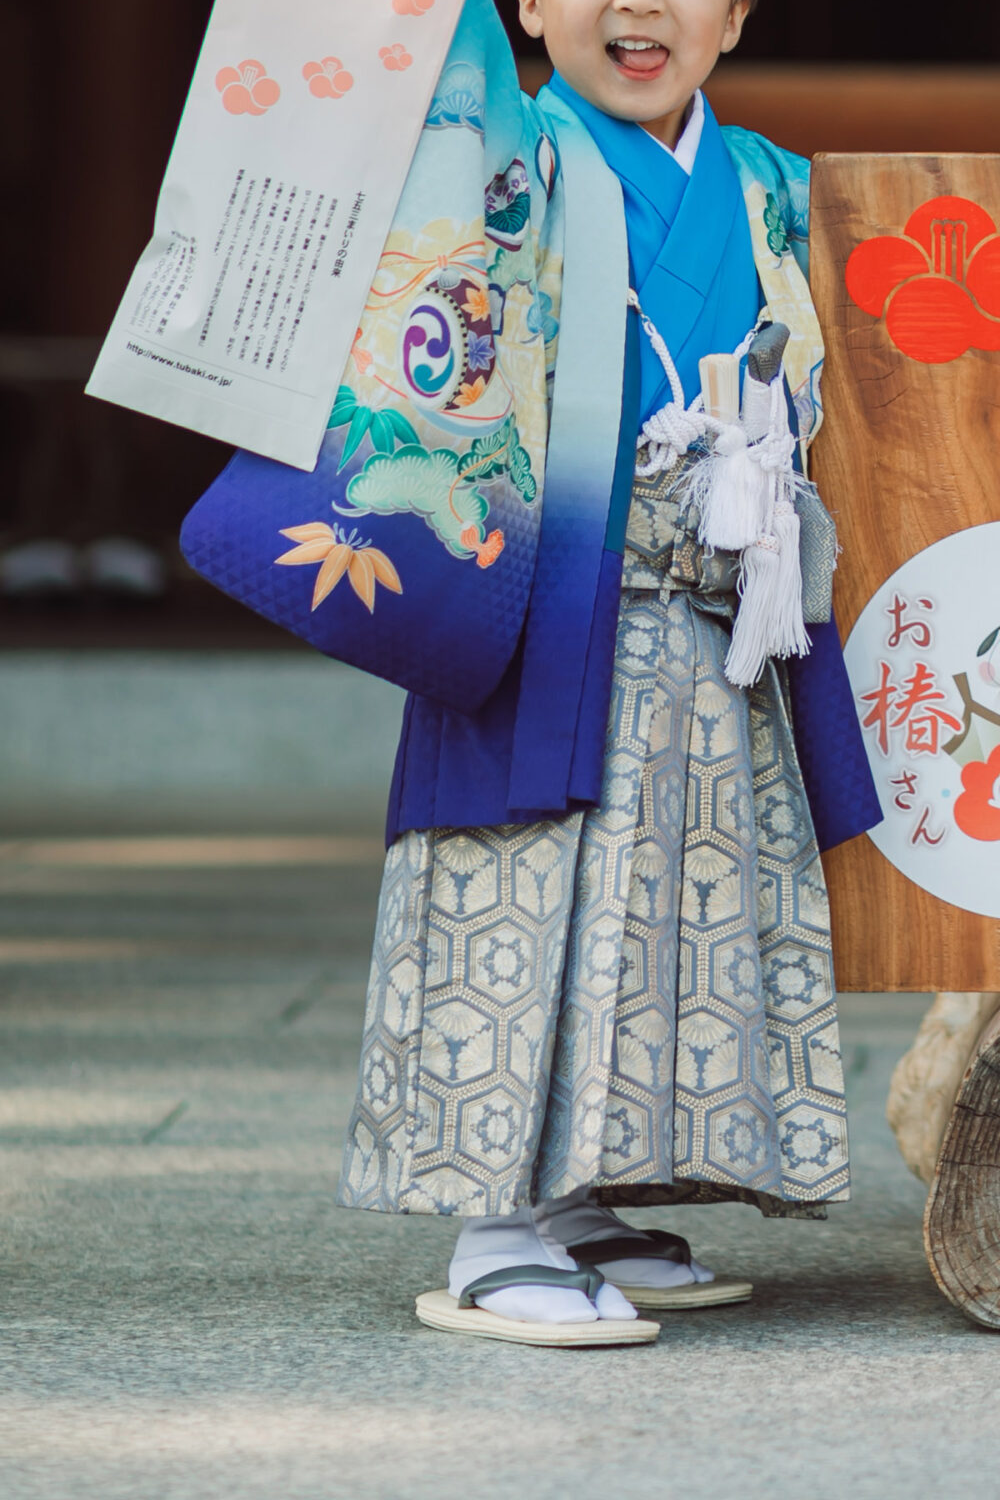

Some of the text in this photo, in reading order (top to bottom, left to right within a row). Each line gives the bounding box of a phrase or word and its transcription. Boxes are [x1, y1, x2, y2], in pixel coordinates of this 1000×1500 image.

[331, 190, 367, 278] 七五三まいりの由来
[126, 340, 233, 387] http://www.tubaki.or.jp/
[862, 593, 963, 847] お椿さん
